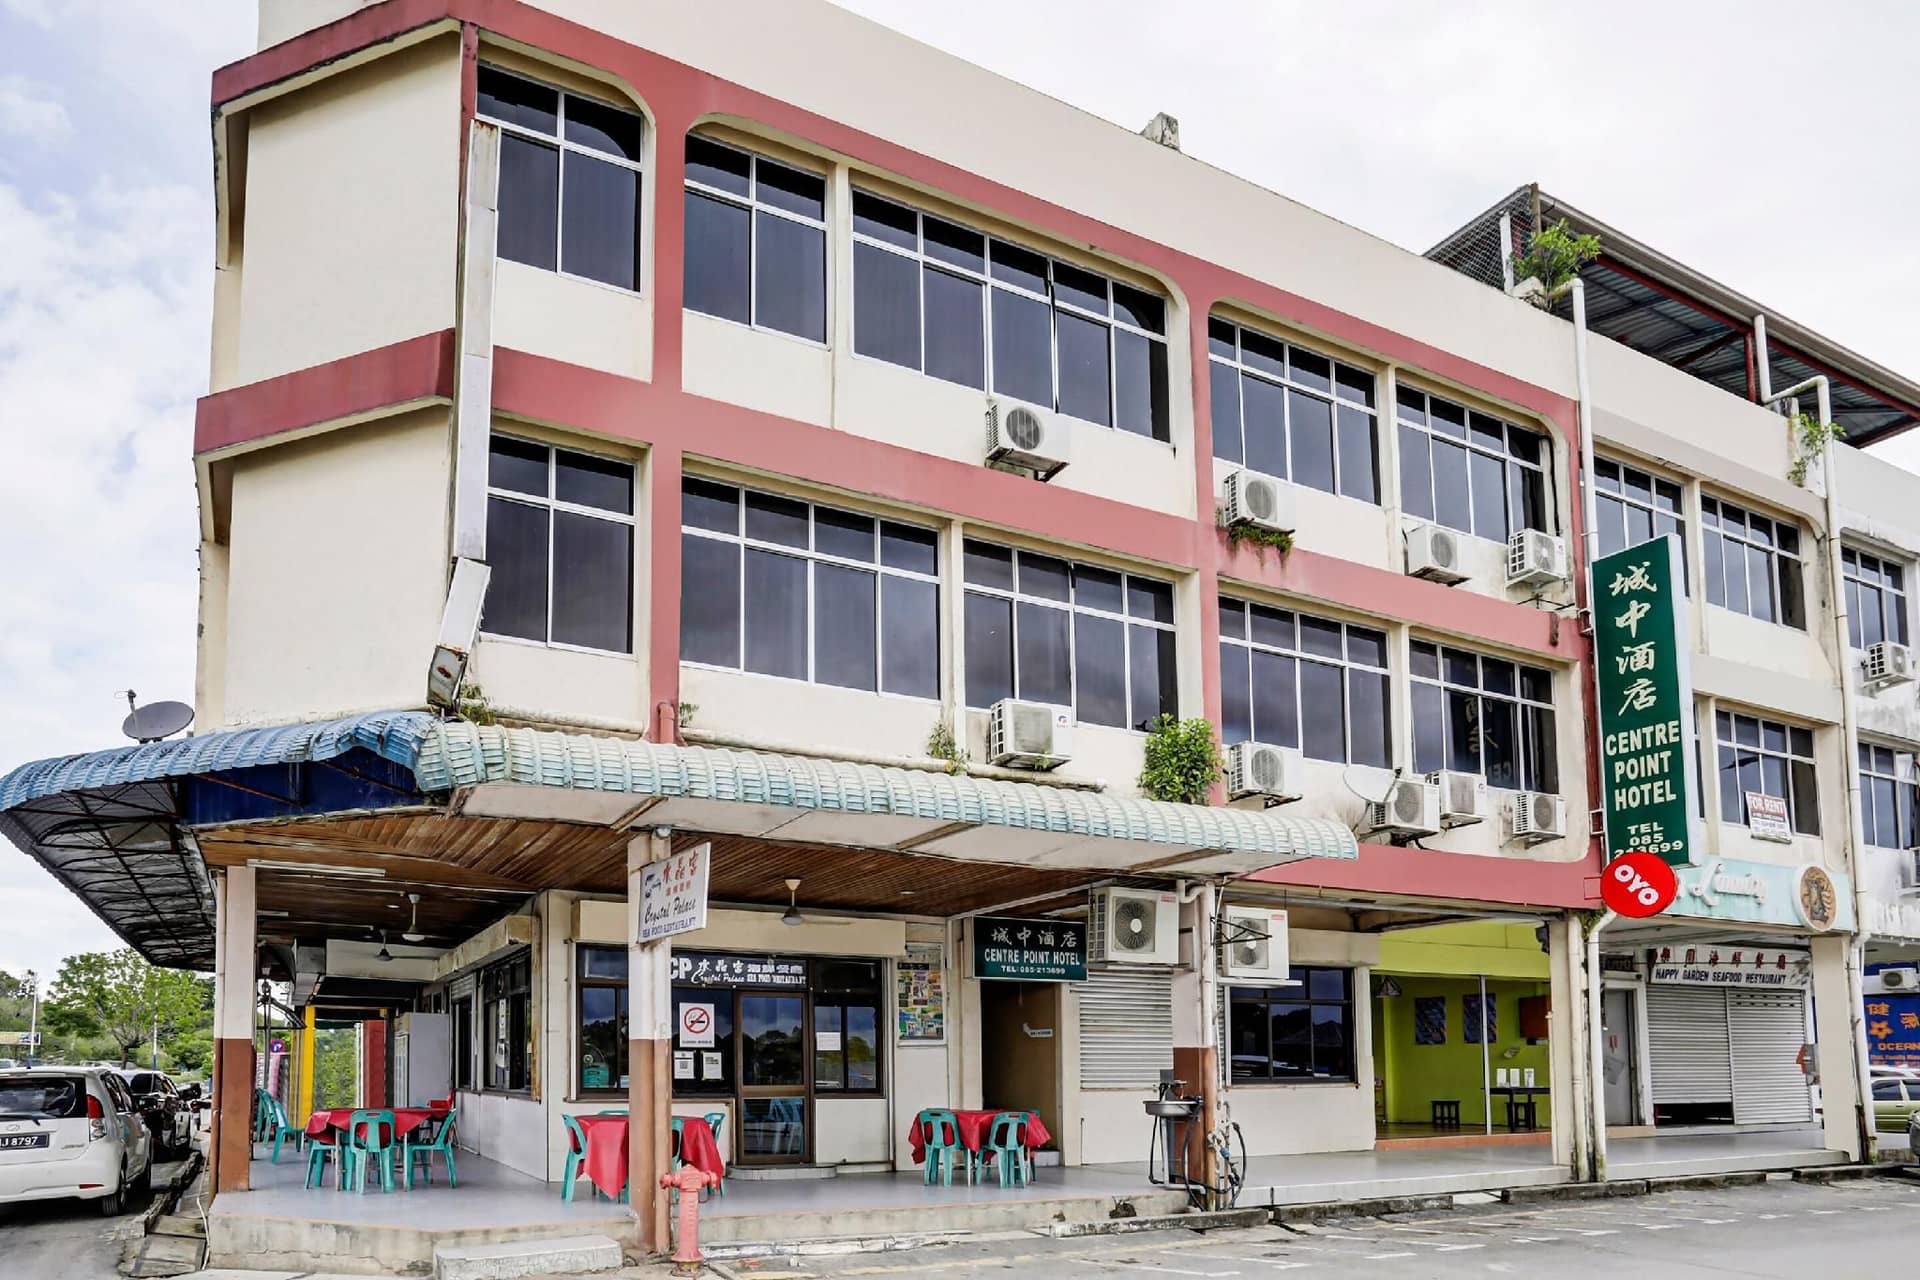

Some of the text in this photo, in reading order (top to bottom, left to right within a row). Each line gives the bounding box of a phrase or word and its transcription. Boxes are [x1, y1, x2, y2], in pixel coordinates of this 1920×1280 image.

[1609, 561, 1658, 717] 城中酒店
[1605, 720, 1681, 756] CENTRE
[1614, 751, 1672, 783] POINT
[1614, 779, 1677, 811] HOTEL
[1627, 822, 1664, 835] TEL
[1629, 833, 1664, 846] 085
[1614, 864, 1660, 907] OYO
[673, 896, 697, 916] Palace
[991, 926, 1078, 948] 城中酒店
[984, 948, 1080, 966] CENTRE POINT HOTEL
[670, 957, 693, 980] CP
[1655, 968, 1787, 985] HAPPY GARDEN SEAFOOD RESTAURANT
[11, 1136, 38, 1146] 8797
